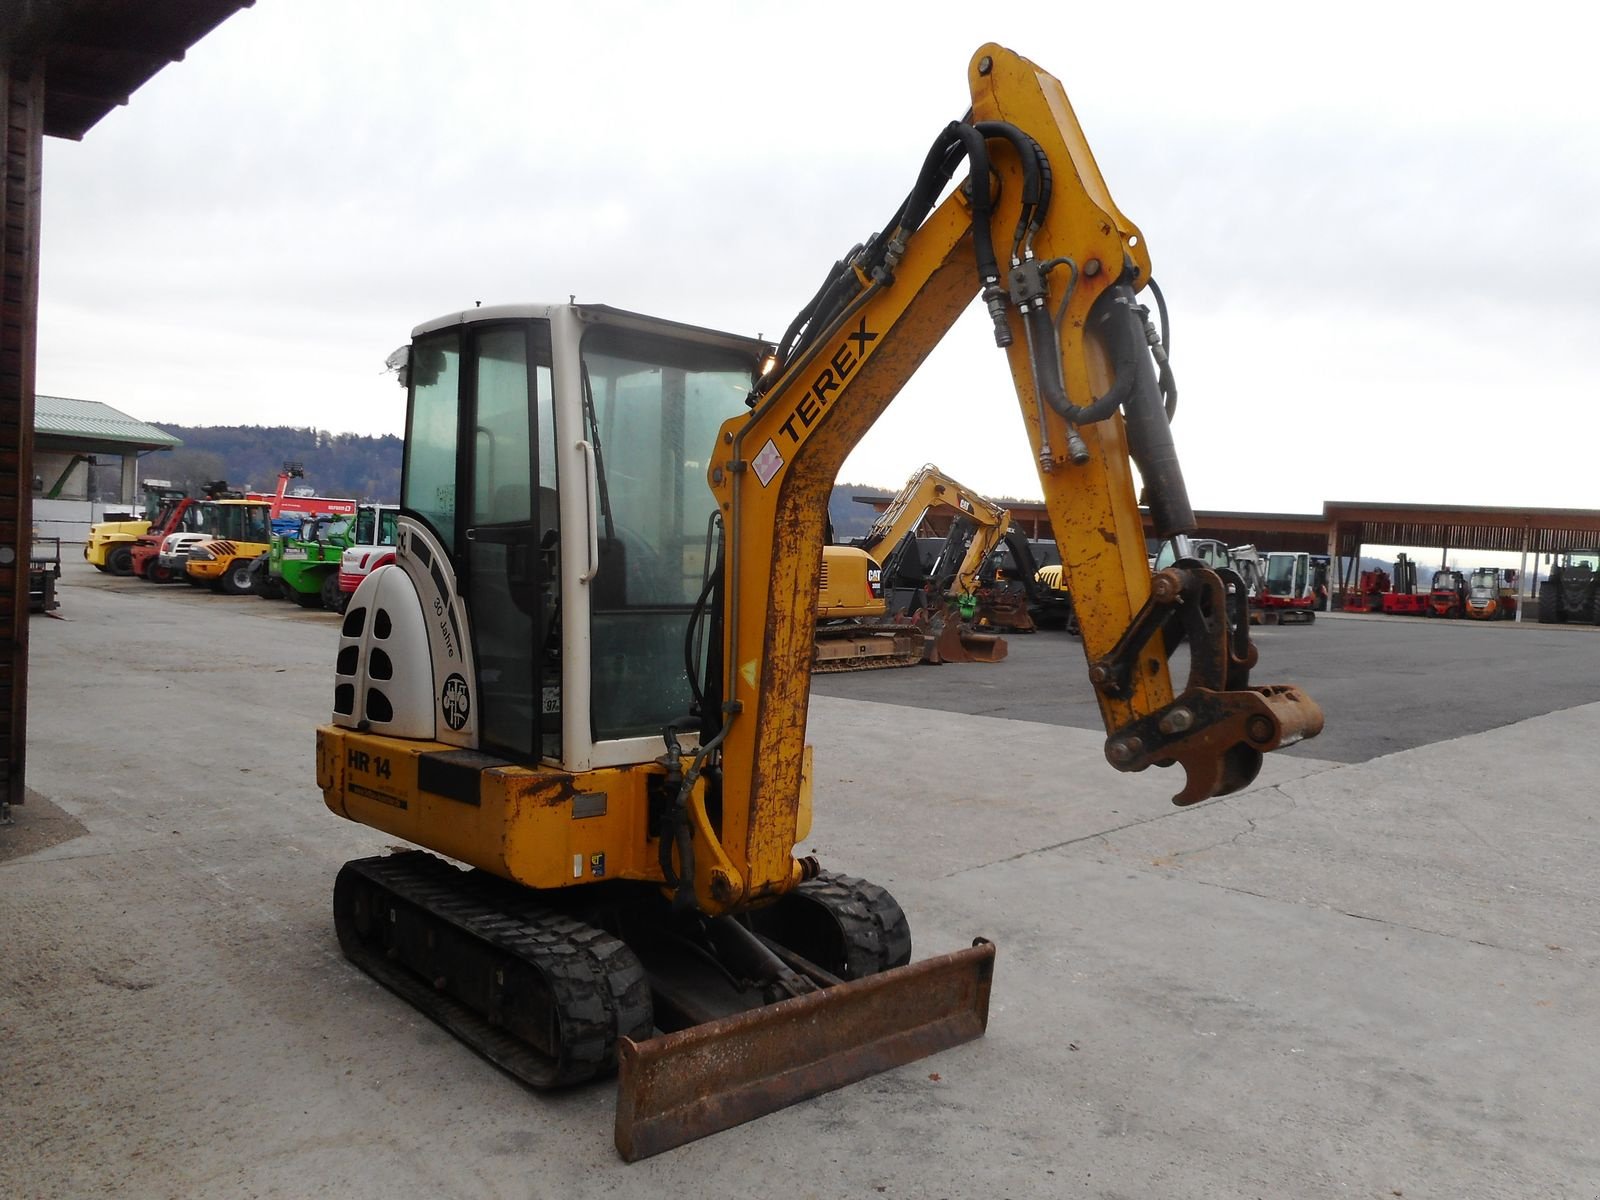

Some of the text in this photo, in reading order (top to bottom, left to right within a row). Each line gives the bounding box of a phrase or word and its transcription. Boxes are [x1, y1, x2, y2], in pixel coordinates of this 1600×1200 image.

[778, 316, 880, 444] TEREX
[960, 499, 970, 511] CAT
[868, 569, 882, 582] CAT
[434, 598, 454, 658] 30 Jahre
[348, 749, 392, 780] HR 14
